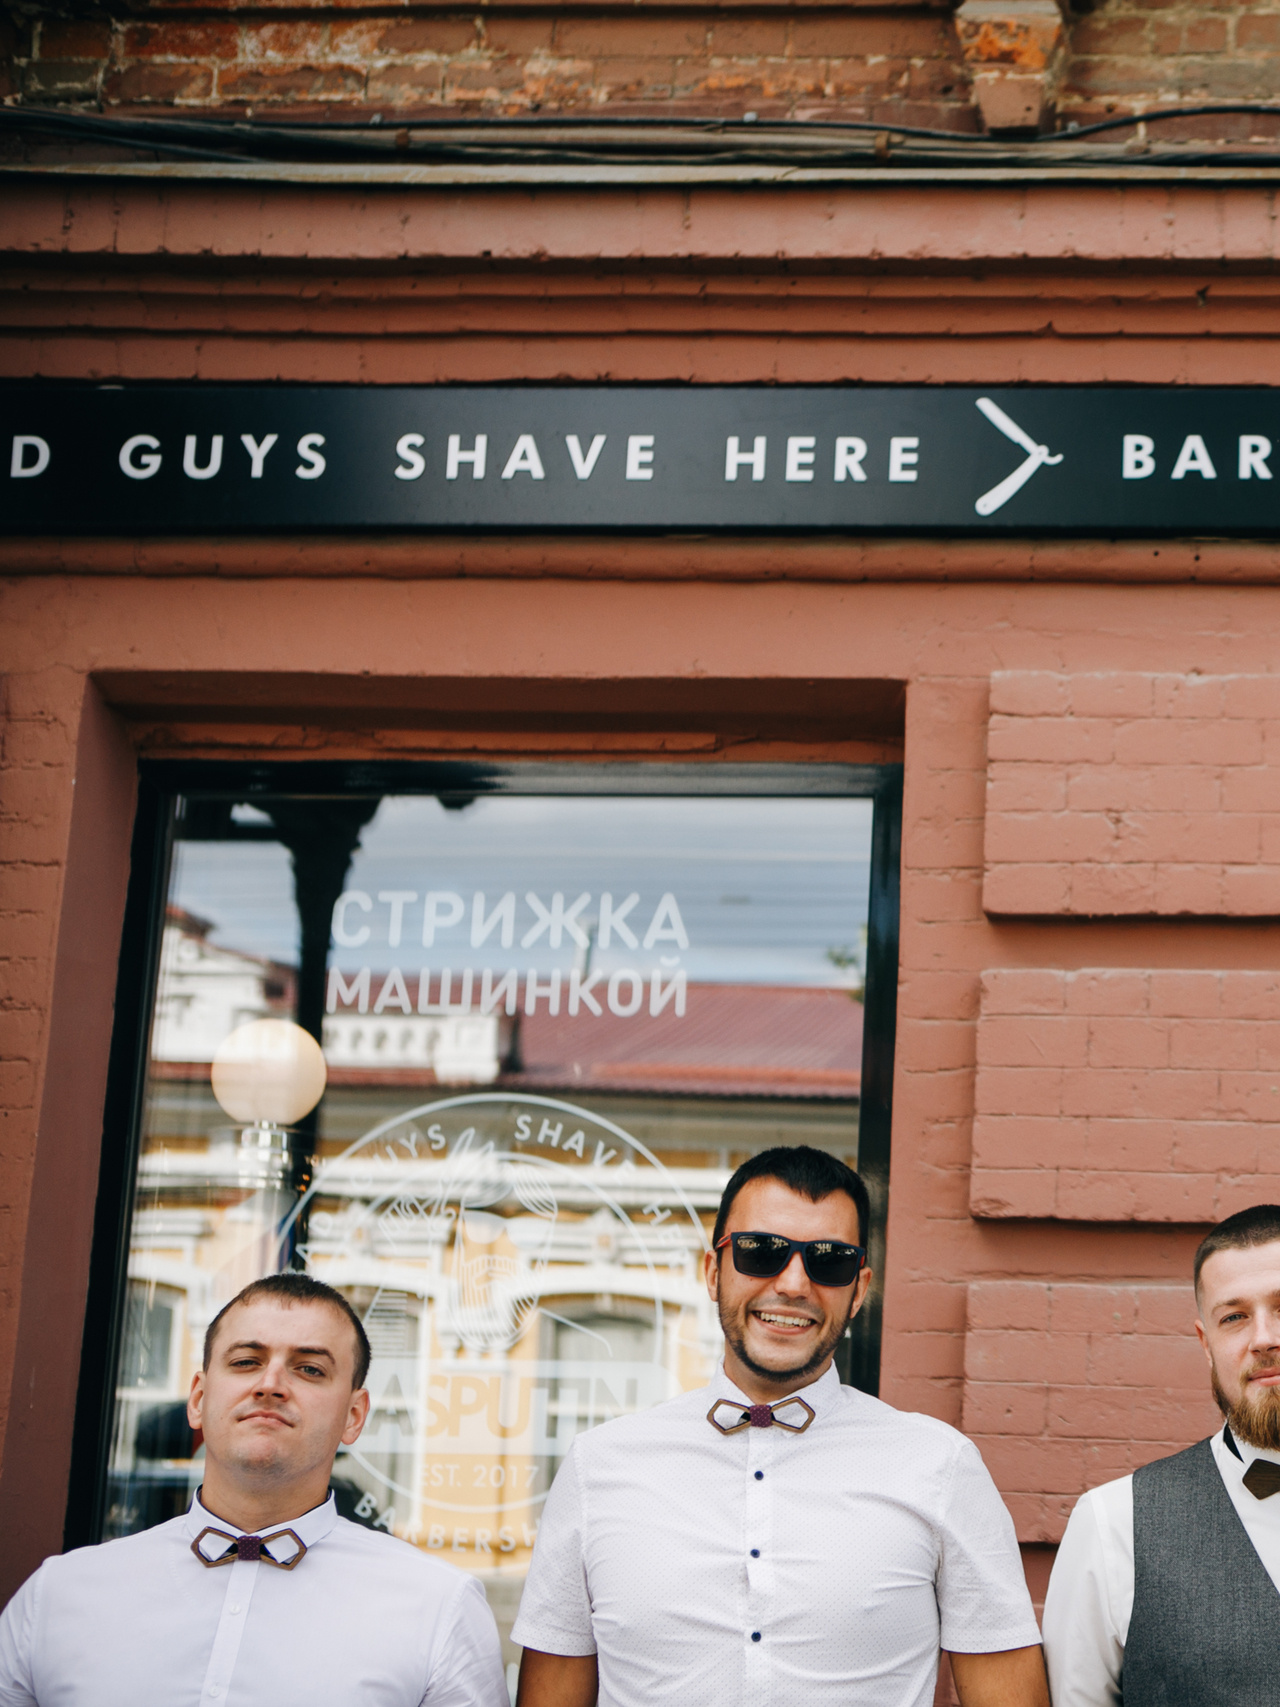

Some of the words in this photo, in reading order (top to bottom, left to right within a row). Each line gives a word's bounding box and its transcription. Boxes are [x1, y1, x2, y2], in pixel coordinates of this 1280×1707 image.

[118, 433, 327, 480] GUYS
[393, 433, 656, 482] SHAVE
[723, 434, 920, 483] HERE
[330, 889, 691, 950] СТРИЖКА
[325, 955, 688, 1018] МАШИНКОЙ
[361, 1372, 639, 1439] ASPUTIN
[472, 1464, 541, 1489] 2017
